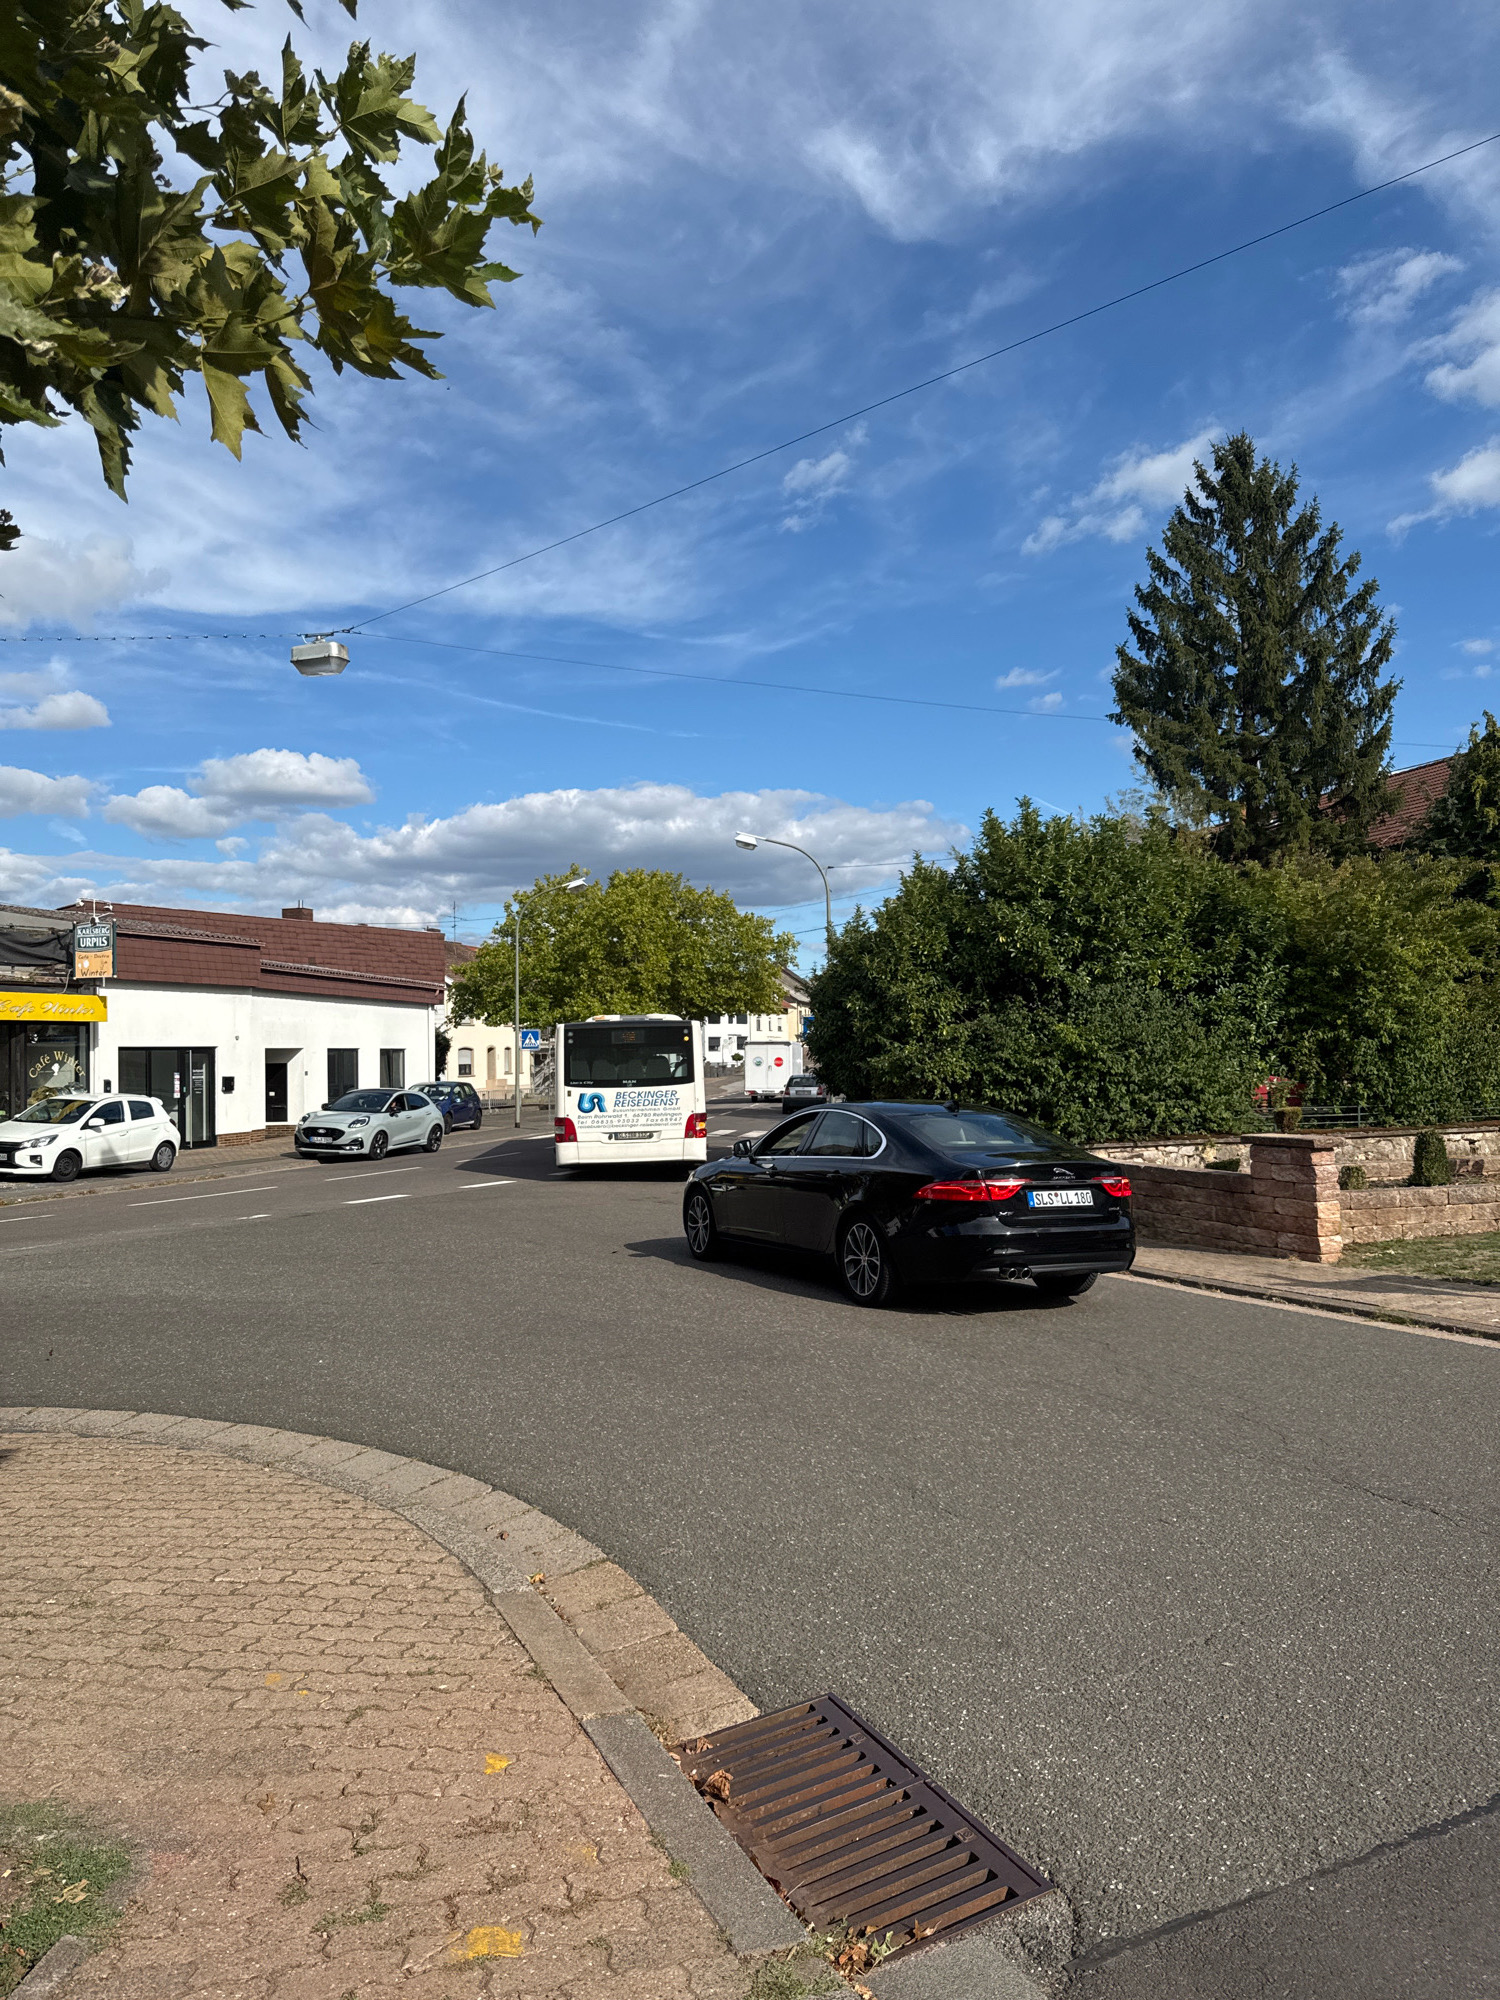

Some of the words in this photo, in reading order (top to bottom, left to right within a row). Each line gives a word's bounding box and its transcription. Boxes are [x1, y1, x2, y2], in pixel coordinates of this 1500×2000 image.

[77, 927, 110, 935] KARLSBERG
[80, 936, 108, 947] URPILS
[80, 968, 108, 977] Winter
[40, 1001, 96, 1015] Winter
[28, 1053, 51, 1078] Café
[53, 1050, 86, 1077] Winter
[616, 1090, 677, 1099] BECKINGER
[614, 1098, 680, 1107] REISEDIENST
[1035, 1191, 1055, 1205] SLS
[1060, 1191, 1073, 1204] LL
